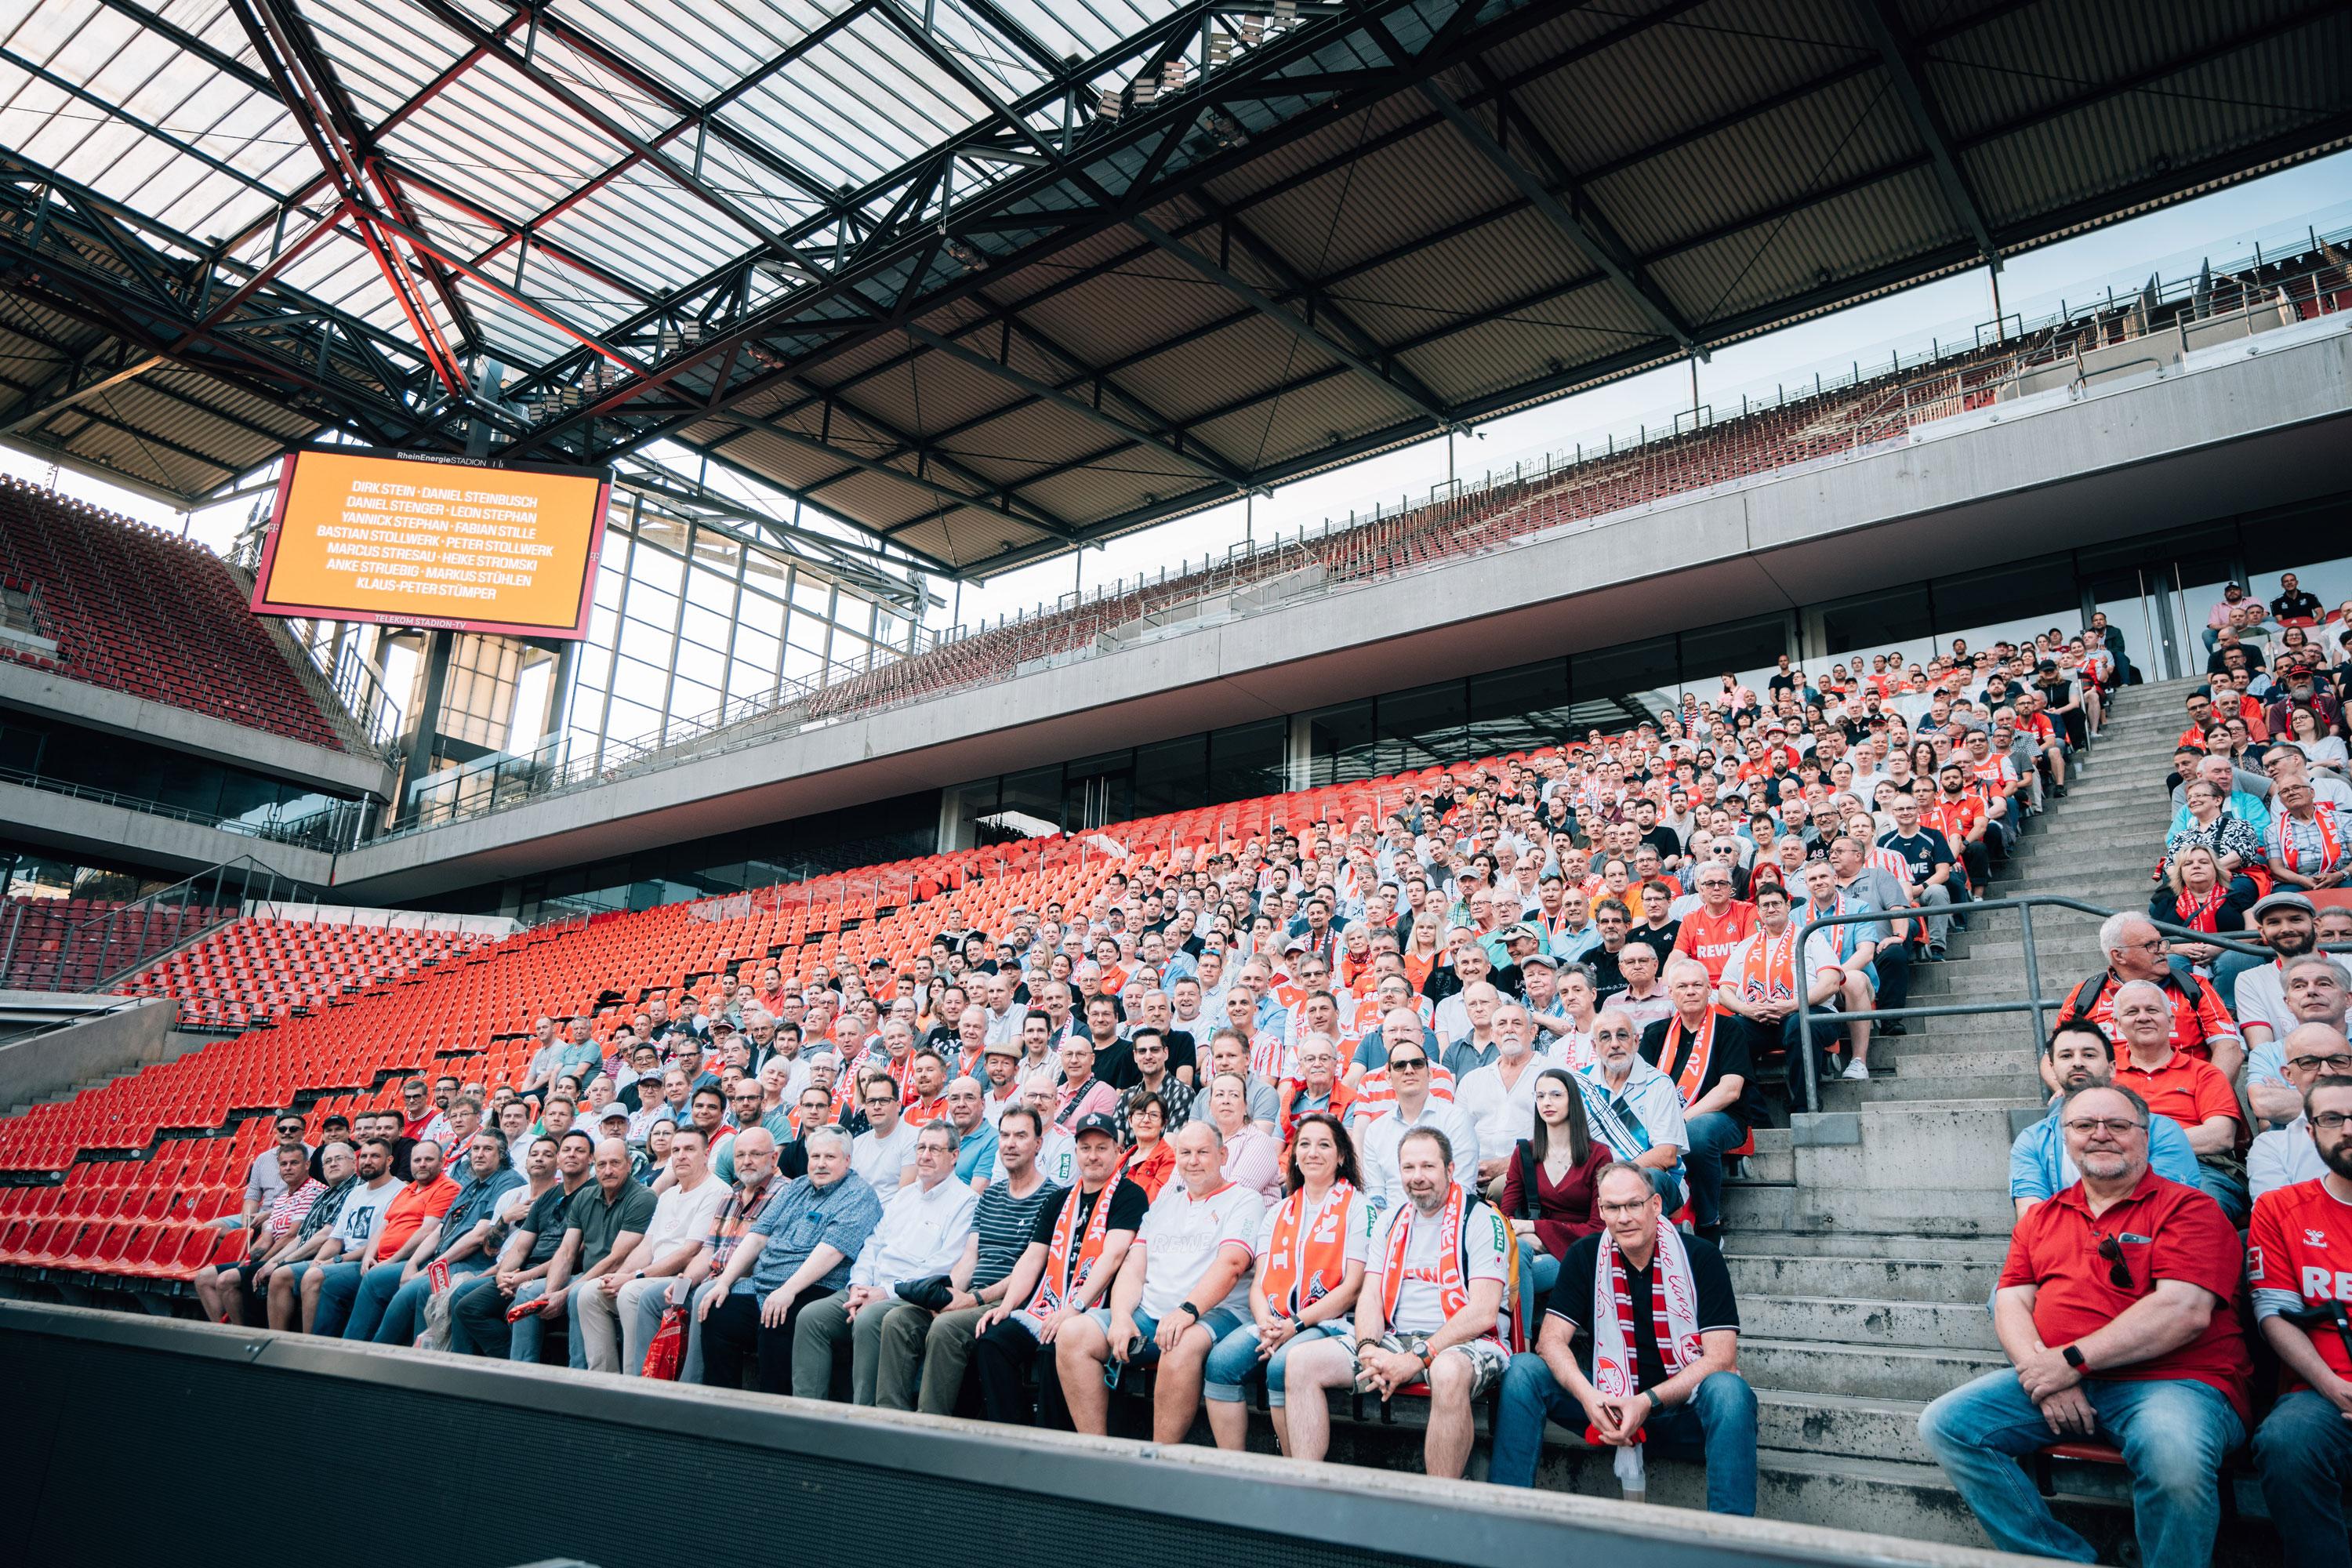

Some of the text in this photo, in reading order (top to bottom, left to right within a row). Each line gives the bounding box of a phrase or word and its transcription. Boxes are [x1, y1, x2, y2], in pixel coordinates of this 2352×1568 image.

[397, 452, 487, 467] RheinEnergieSTADION
[352, 480, 539, 509] DIRK STEIN DANIEL STEINBUSCH
[347, 495, 538, 524] DANIEL STENGER LEON STEPHAN
[342, 511, 537, 540] YANNICK STEPHAN FABIAN STILLE
[317, 524, 554, 557] BASTIAN STOLLWERK PETER STOLLWERK
[327, 542, 538, 572] MARCUS STRESAU HEIKE STROMSKI
[326, 558, 532, 587] ANKE STRUEBIG MARKUS STÜHLEN
[357, 576, 497, 601] KLAUS-PETER STÜMPER
[375, 614, 467, 630] TELEKOM STADION-TV
[1810, 849, 1825, 859] 48
[1907, 862, 1929, 874] WE
[1685, 1051, 1700, 1076] 20
[1061, 1155, 1071, 1178] DEVK
[1153, 1232, 1213, 1254] REWE
[1494, 1216, 1504, 1250] DEVK
